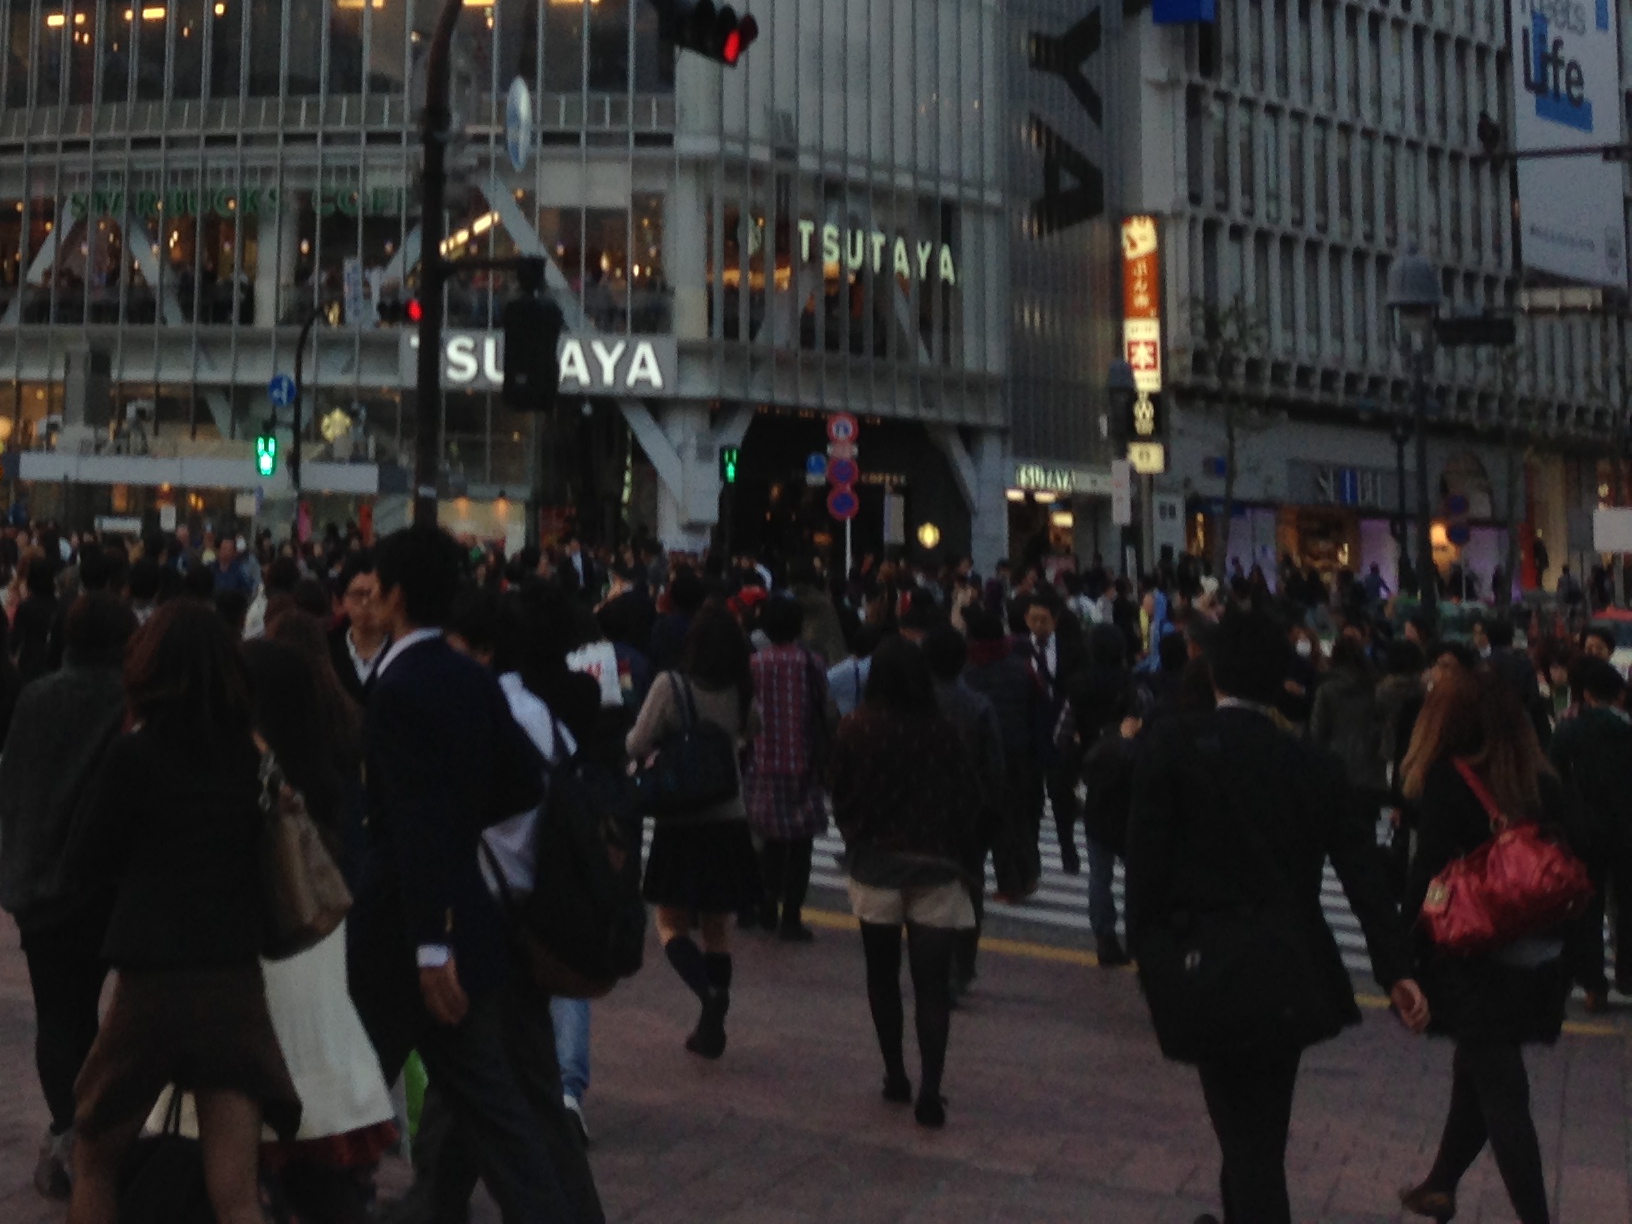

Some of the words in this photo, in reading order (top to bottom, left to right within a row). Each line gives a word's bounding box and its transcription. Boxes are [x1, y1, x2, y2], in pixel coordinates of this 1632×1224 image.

[1521, 24, 1586, 109] Life
[68, 188, 284, 219] STARBUCKS
[798, 219, 956, 284] TSUTAYA
